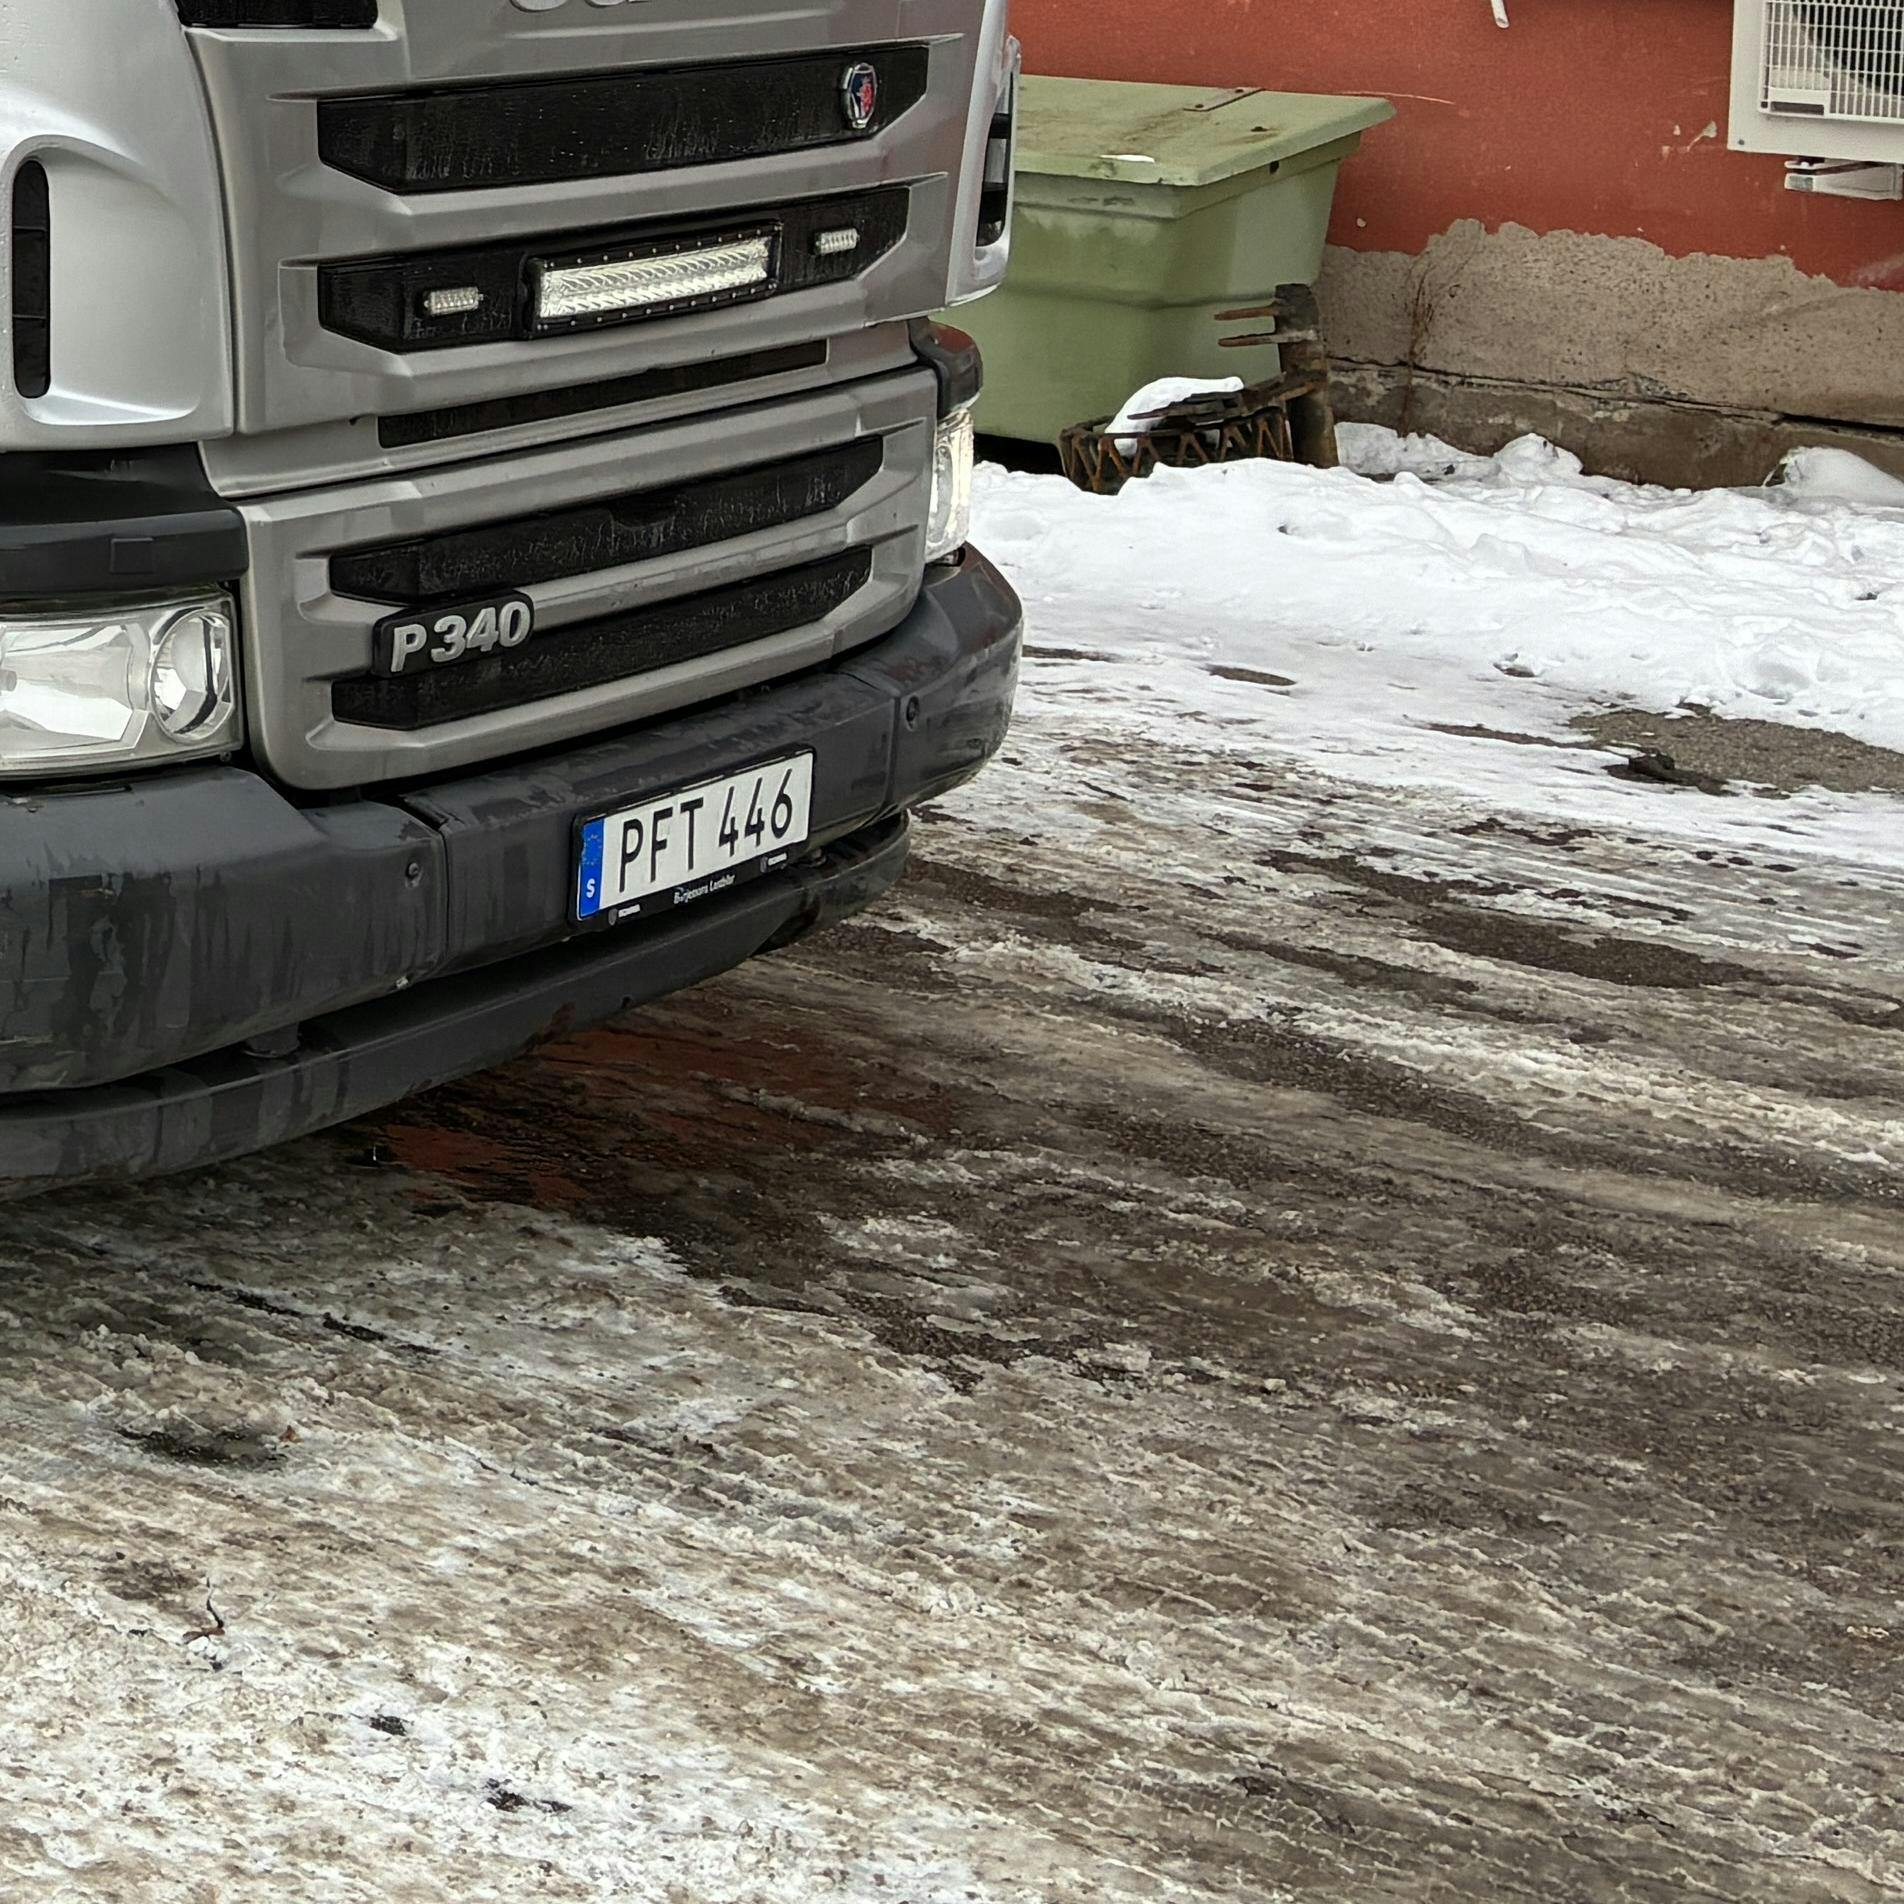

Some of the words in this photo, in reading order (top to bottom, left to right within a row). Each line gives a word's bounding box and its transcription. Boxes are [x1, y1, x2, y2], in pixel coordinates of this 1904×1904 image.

[619, 797, 704, 893] PFT
[719, 768, 793, 858] 446
[586, 878, 596, 899] S
